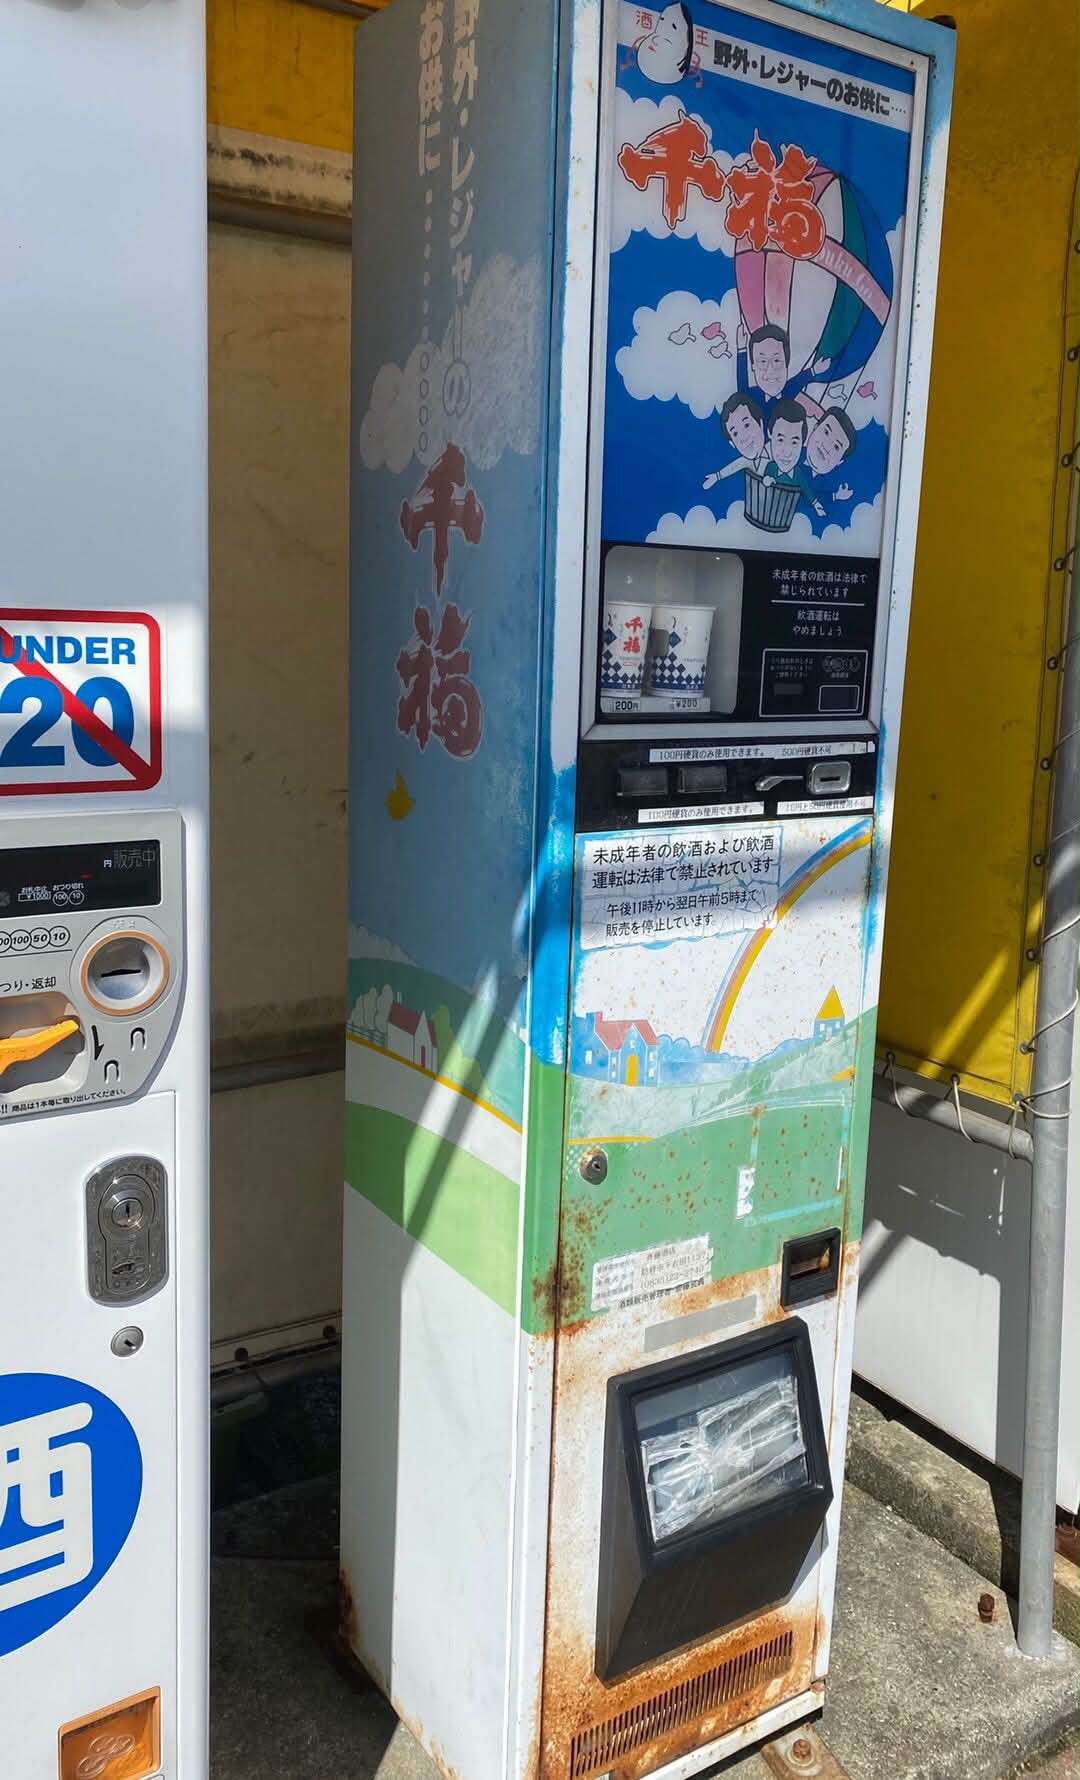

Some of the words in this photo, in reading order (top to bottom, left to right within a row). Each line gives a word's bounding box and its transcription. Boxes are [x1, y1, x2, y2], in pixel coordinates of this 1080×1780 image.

[618, 109, 827, 261] 千福
[772, 568, 867, 584] 未成年者の飲酒は法律で
[781, 584, 849, 598] 禁じられています
[397, 441, 484, 760] 千福
[797, 609, 840, 621] 飲酒運転は
[624, 616, 643, 653] 千福
[792, 625, 842, 636] やめましょう
[0, 635, 136, 665] UNDER
[0, 676, 134, 767] 20
[103, 859, 112, 868] 円
[114, 849, 156, 869] 販売中
[592, 834, 775, 865] 未成年者の飲酒および飲酒
[591, 856, 774, 889] 運転は法律で禁止されています
[606, 888, 759, 918] 午後11時から翌日午前5時まで
[13, 936, 30, 945] 100
[33, 934, 48, 942] 50
[53, 932, 66, 941] 10
[605, 912, 714, 937] 販売を停止しています
